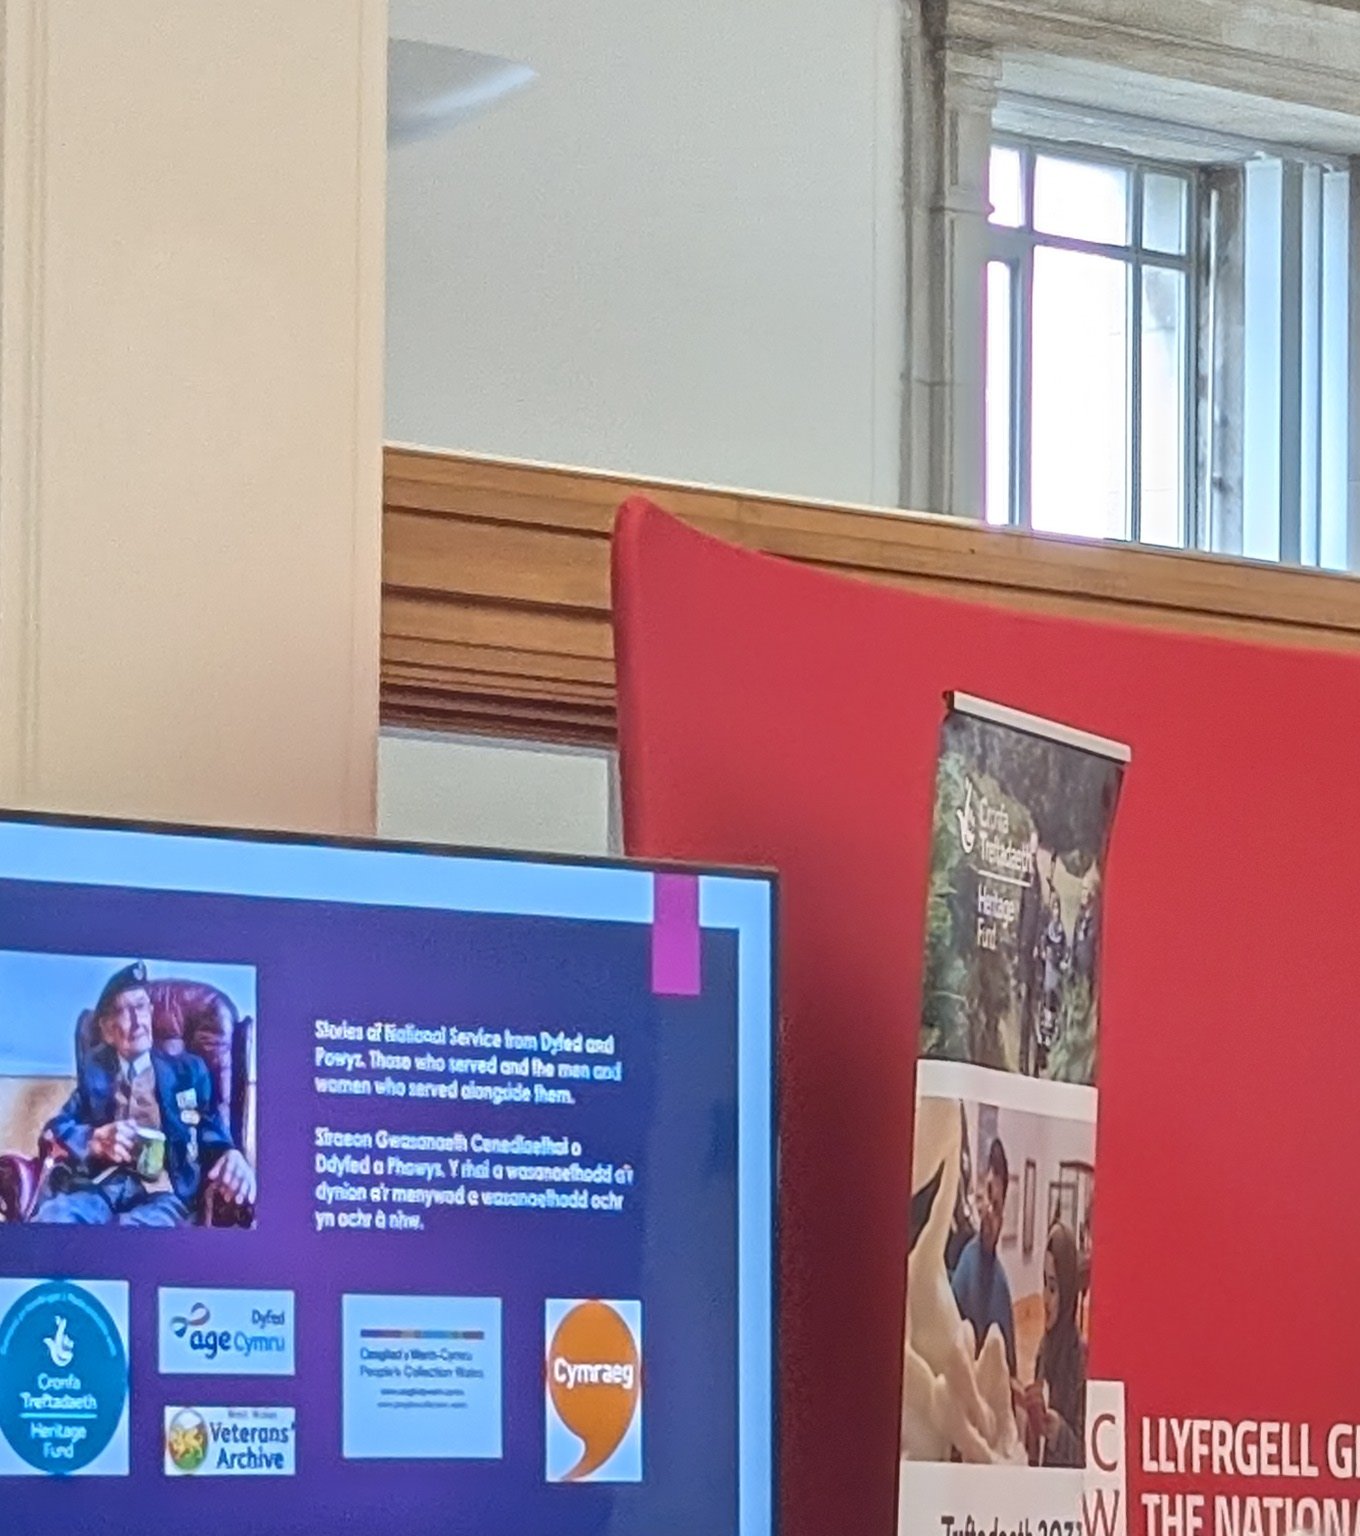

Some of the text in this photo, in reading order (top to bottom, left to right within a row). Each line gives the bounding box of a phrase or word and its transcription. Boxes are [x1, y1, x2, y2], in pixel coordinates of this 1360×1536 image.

[977, 917, 997, 950] Fund
[449, 1026, 501, 1047] Service
[505, 1029, 537, 1050] from
[540, 1032, 582, 1055] Dyfed
[586, 1035, 615, 1054] and
[415, 1053, 445, 1072] who
[448, 1055, 497, 1075] served
[501, 1058, 529, 1077] and
[593, 1062, 622, 1081] and
[315, 1078, 371, 1095] women
[374, 1077, 406, 1096] who
[409, 1078, 458, 1099] served
[315, 1211, 335, 1231] yn
[251, 1309, 285, 1329] Dyfed
[190, 1329, 285, 1360] age Cymru
[37, 1373, 81, 1391] Cronfa
[554, 1357, 634, 1389] Cymraeg
[30, 1422, 87, 1443] Heritage
[209, 1421, 296, 1444] Veterans'
[42, 1442, 74, 1459] Fund
[216, 1446, 284, 1469] Archive
[1141, 1416, 1319, 1478] LLYFRGELL
